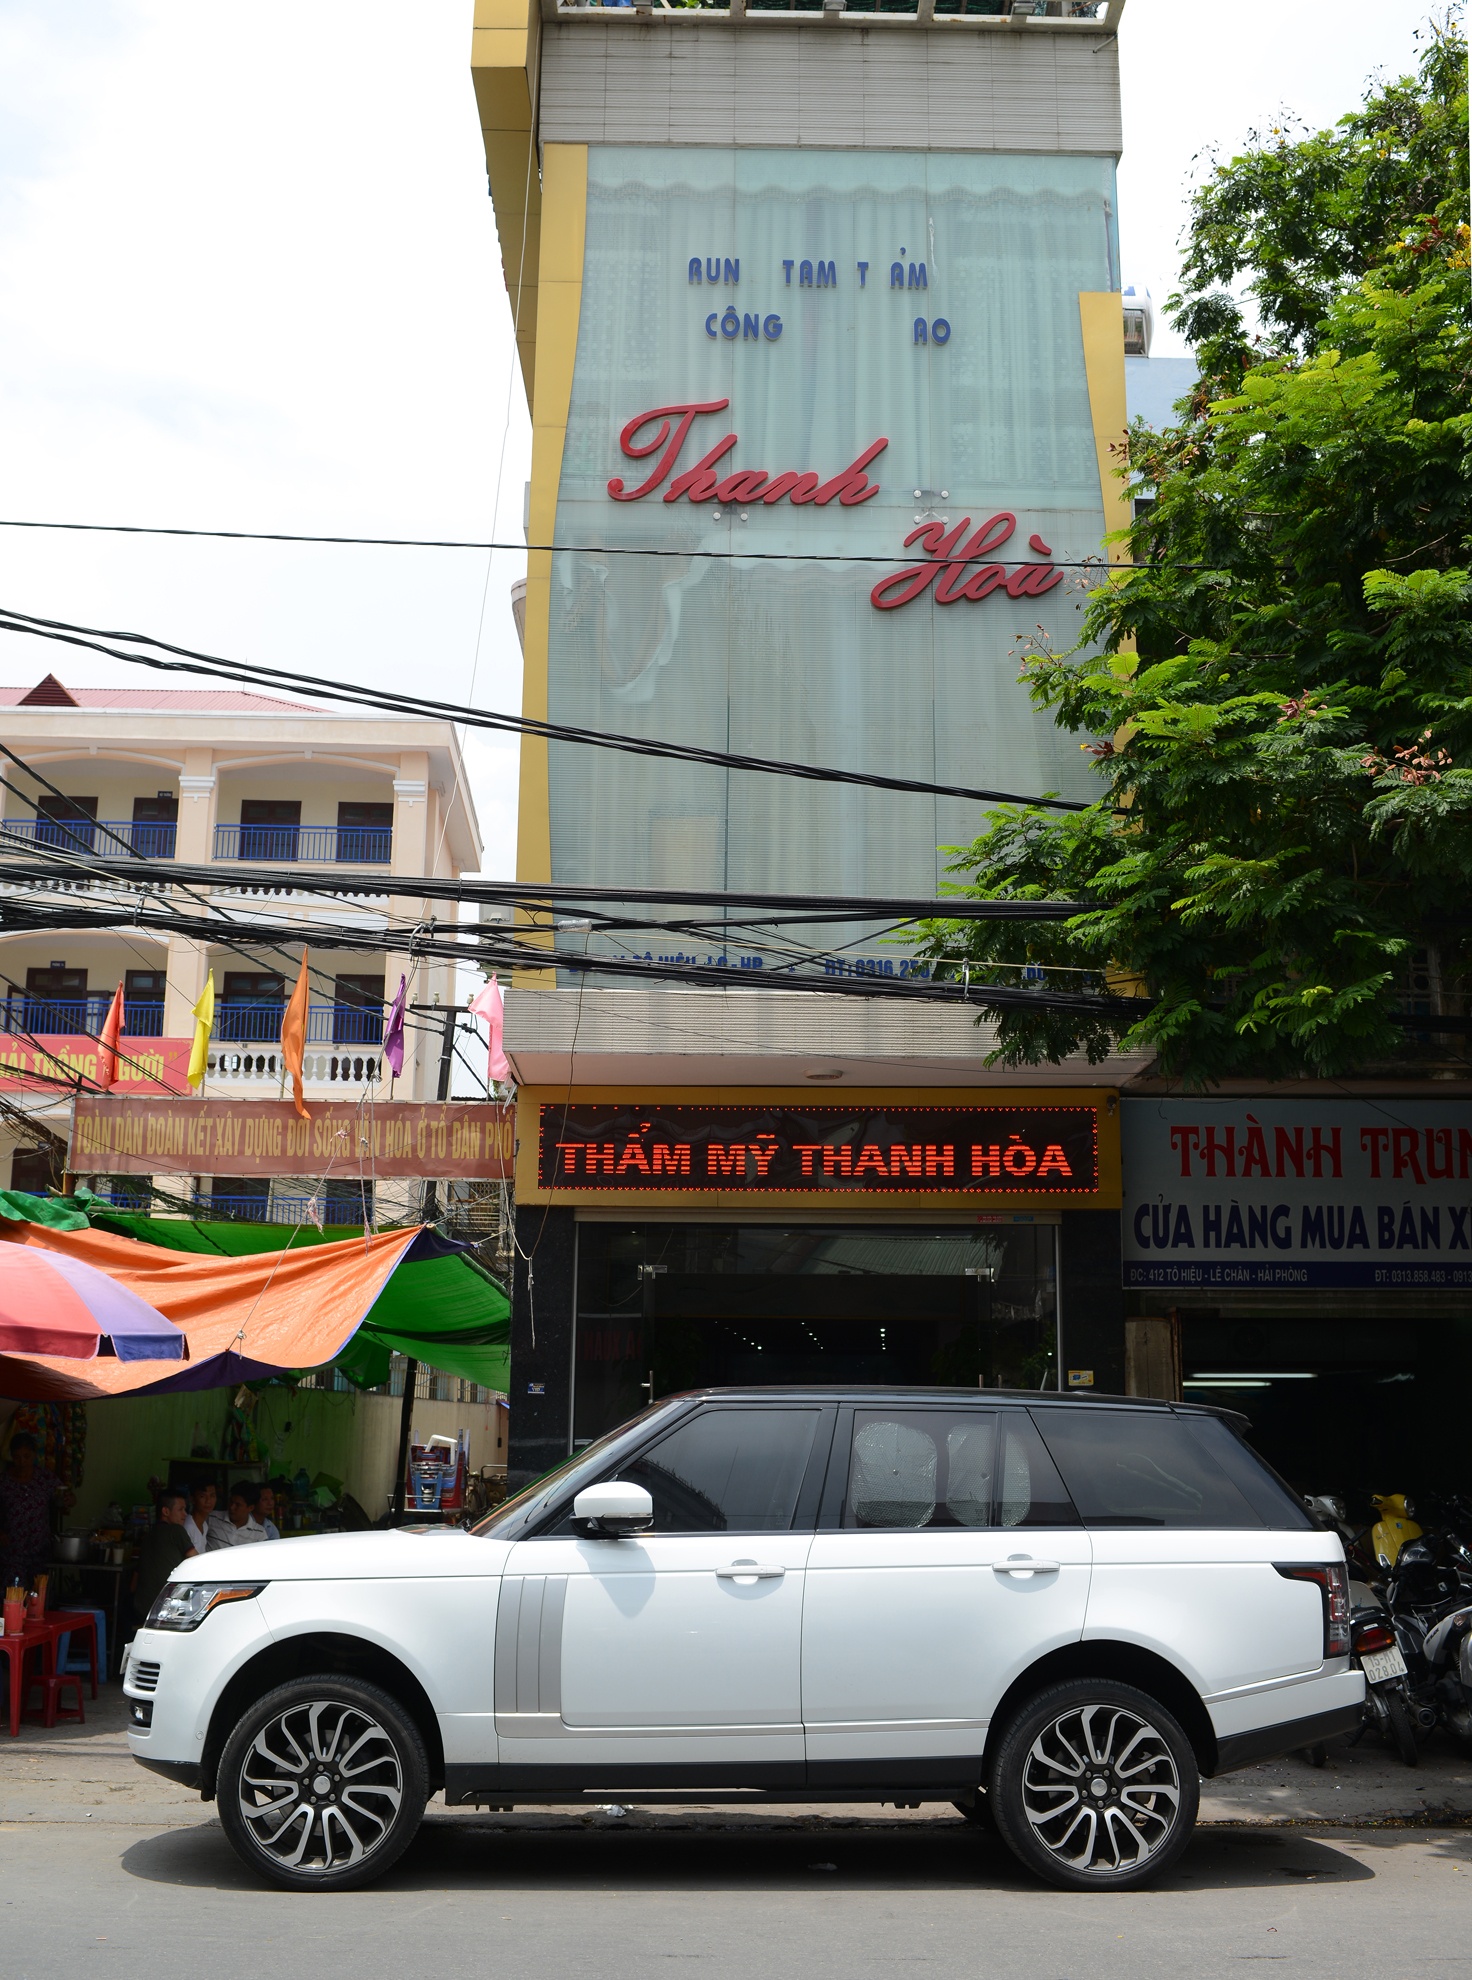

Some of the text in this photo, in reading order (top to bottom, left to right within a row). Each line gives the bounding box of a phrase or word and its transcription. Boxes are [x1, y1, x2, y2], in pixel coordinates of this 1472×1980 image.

[689, 257, 740, 284] RUN
[782, 259, 837, 288] TAM
[704, 305, 951, 345] CÔNG AO
[607, 398, 889, 507] Thanh
[870, 511, 1065, 611] Hoà
[118, 1048, 165, 1082] GƯỜI
[76, 1109, 112, 1155] TOÀN
[114, 1110, 143, 1155] DÂN
[146, 1109, 185, 1156] ĐOÀN
[187, 1105, 213, 1156] KẾT
[214, 1110, 242, 1156] XÂY
[244, 1114, 282, 1164] DỰNG
[313, 1107, 351, 1158] SỐNG
[385, 1113, 412, 1158] HÓA
[417, 1106, 427, 1159] Ở
[430, 1105, 447, 1159] TỔ
[451, 1114, 480, 1159] DÂN
[485, 1109, 513, 1160] PHỐ
[1170, 1112, 1343, 1179] THÀNH
[707, 1135, 779, 1176] MỸ
[792, 1144, 955, 1177] THANH
[1133, 1193, 1472, 1250] CỬA HÀNG MUA BÁN X
[1130, 1268, 1147, 1282] ĐC:
[1148, 1268, 1164, 1282] 412
[1166, 1265, 1179, 1282] TÔ
[1181, 1265, 1202, 1284] HIỆU
[1210, 1265, 1221, 1282] LÊ
[1224, 1265, 1250, 1282] CHÂN
[1257, 1263, 1273, 1282] HẢI
[1275, 1265, 1308, 1283] PHÒNG
[1375, 1269, 1389, 1282] ĐT:
[1391, 1269, 1446, 1283] 0313.858.483
